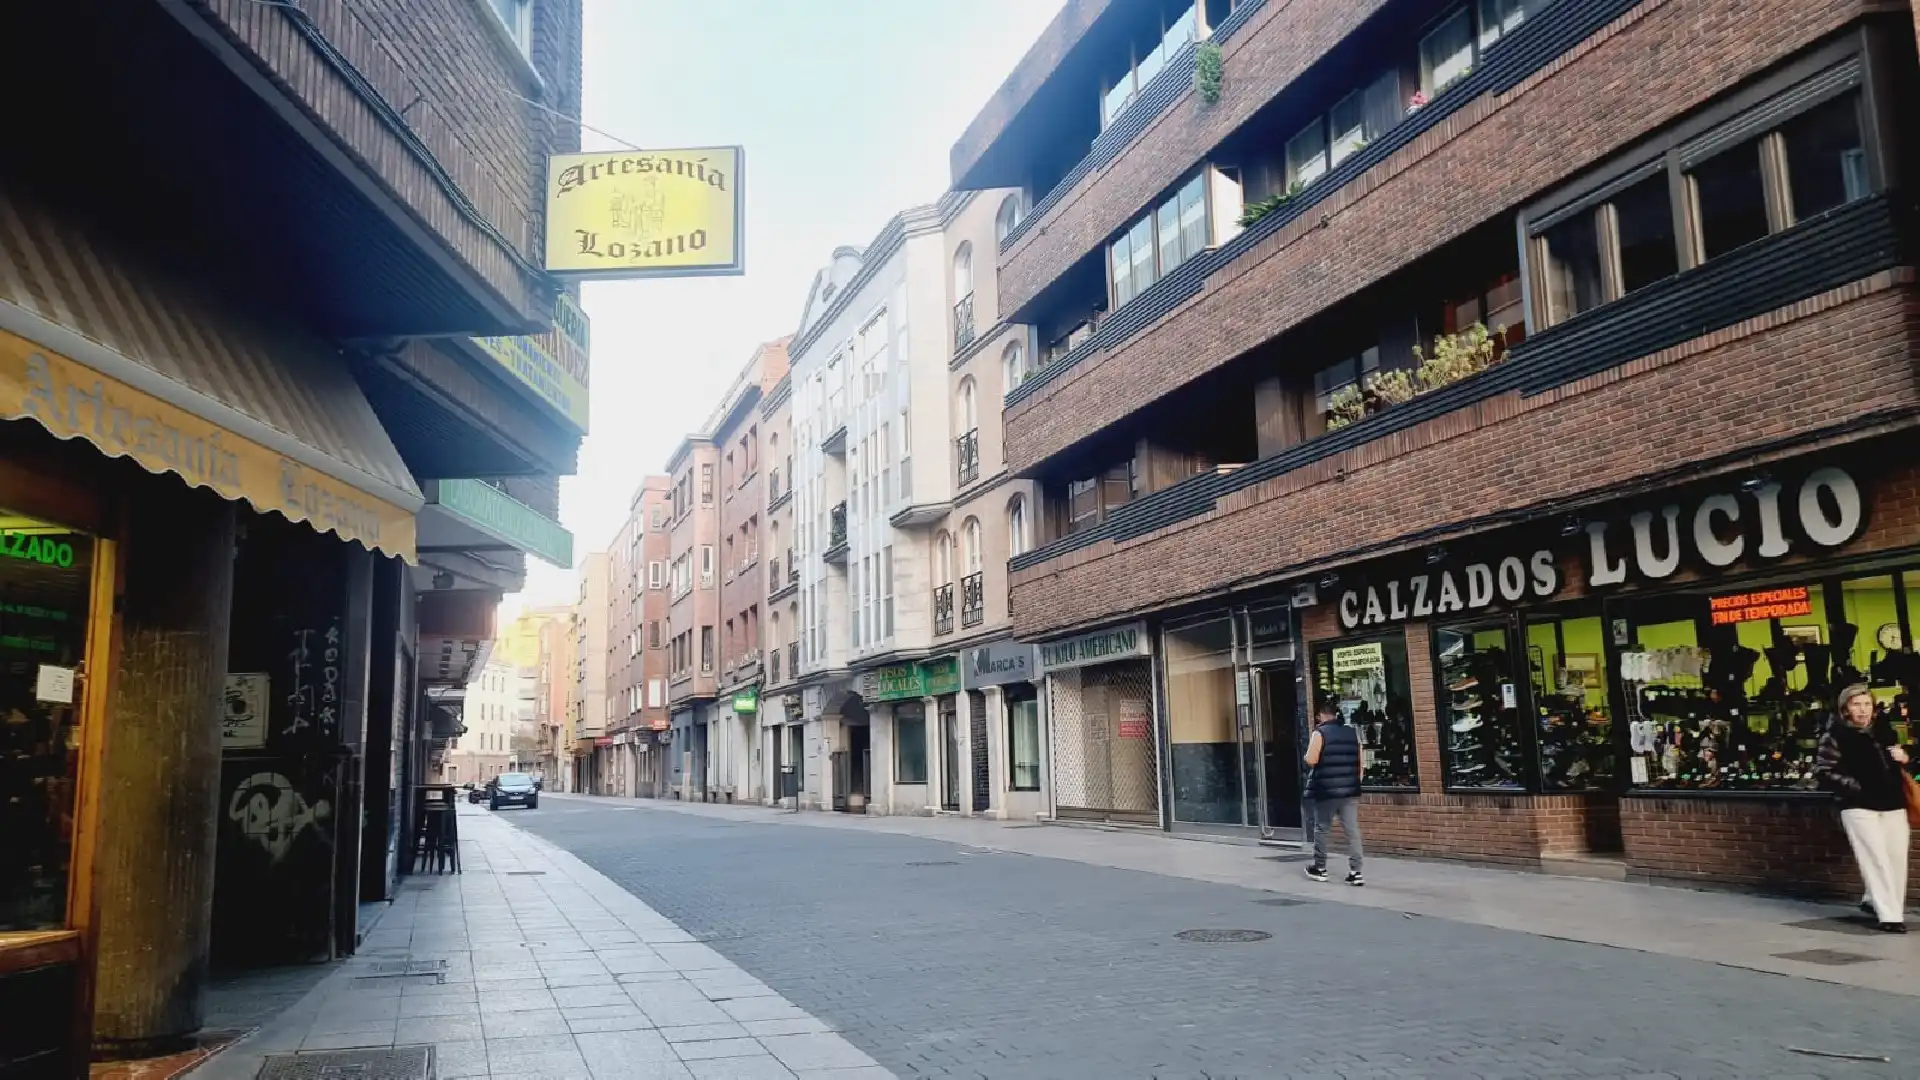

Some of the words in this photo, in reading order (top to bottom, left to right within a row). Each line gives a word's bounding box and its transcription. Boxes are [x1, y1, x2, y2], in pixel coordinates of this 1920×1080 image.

[557, 154, 727, 198] Artesanía
[575, 229, 707, 263] Lozano
[1339, 549, 1557, 628] CALZADOS
[1585, 466, 1862, 587] LUCIO
[1750, 587, 1806, 605] ESPECIALES
[1079, 629, 1137, 660] AMERICANO
[877, 675, 921, 692] LOCALES
